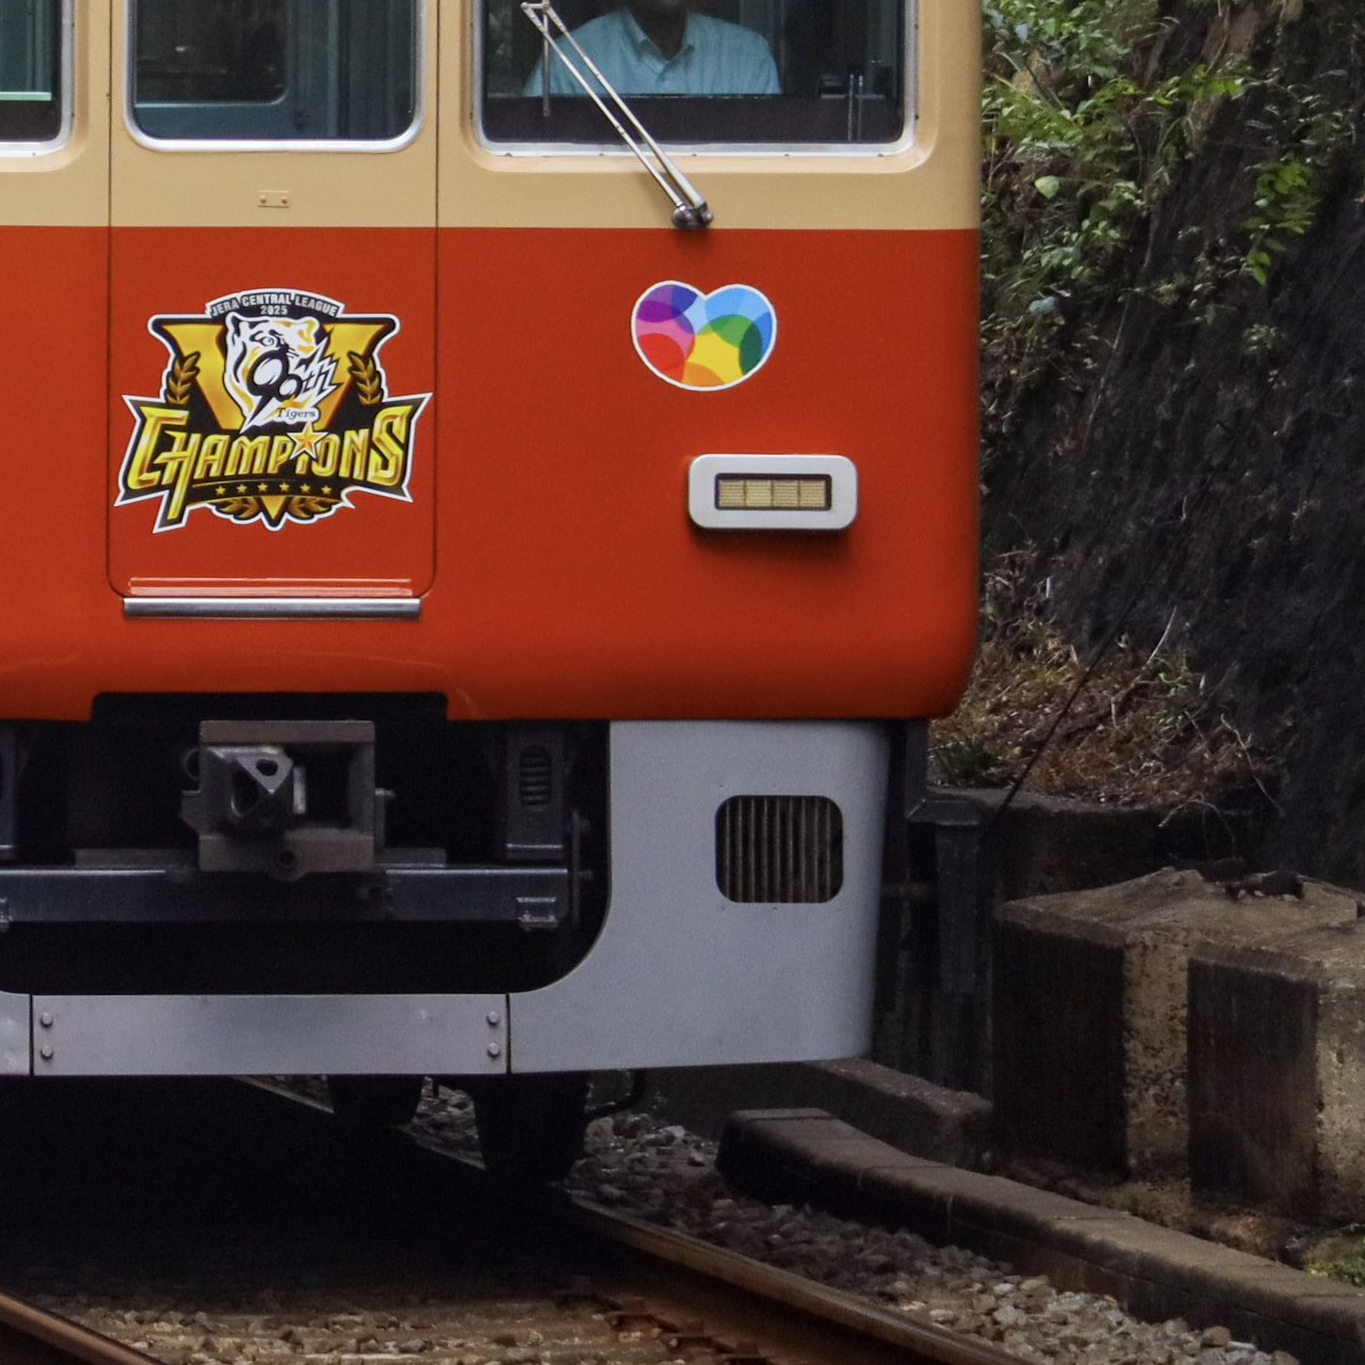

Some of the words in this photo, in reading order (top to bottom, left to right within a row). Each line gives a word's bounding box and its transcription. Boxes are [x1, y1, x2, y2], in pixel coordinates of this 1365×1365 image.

[212, 297, 240, 317] JERA
[241, 293, 292, 308] CENTRAL
[294, 296, 338, 317] LEAGUE
[260, 305, 288, 316] 2025
[276, 407, 316, 420] Tigers
